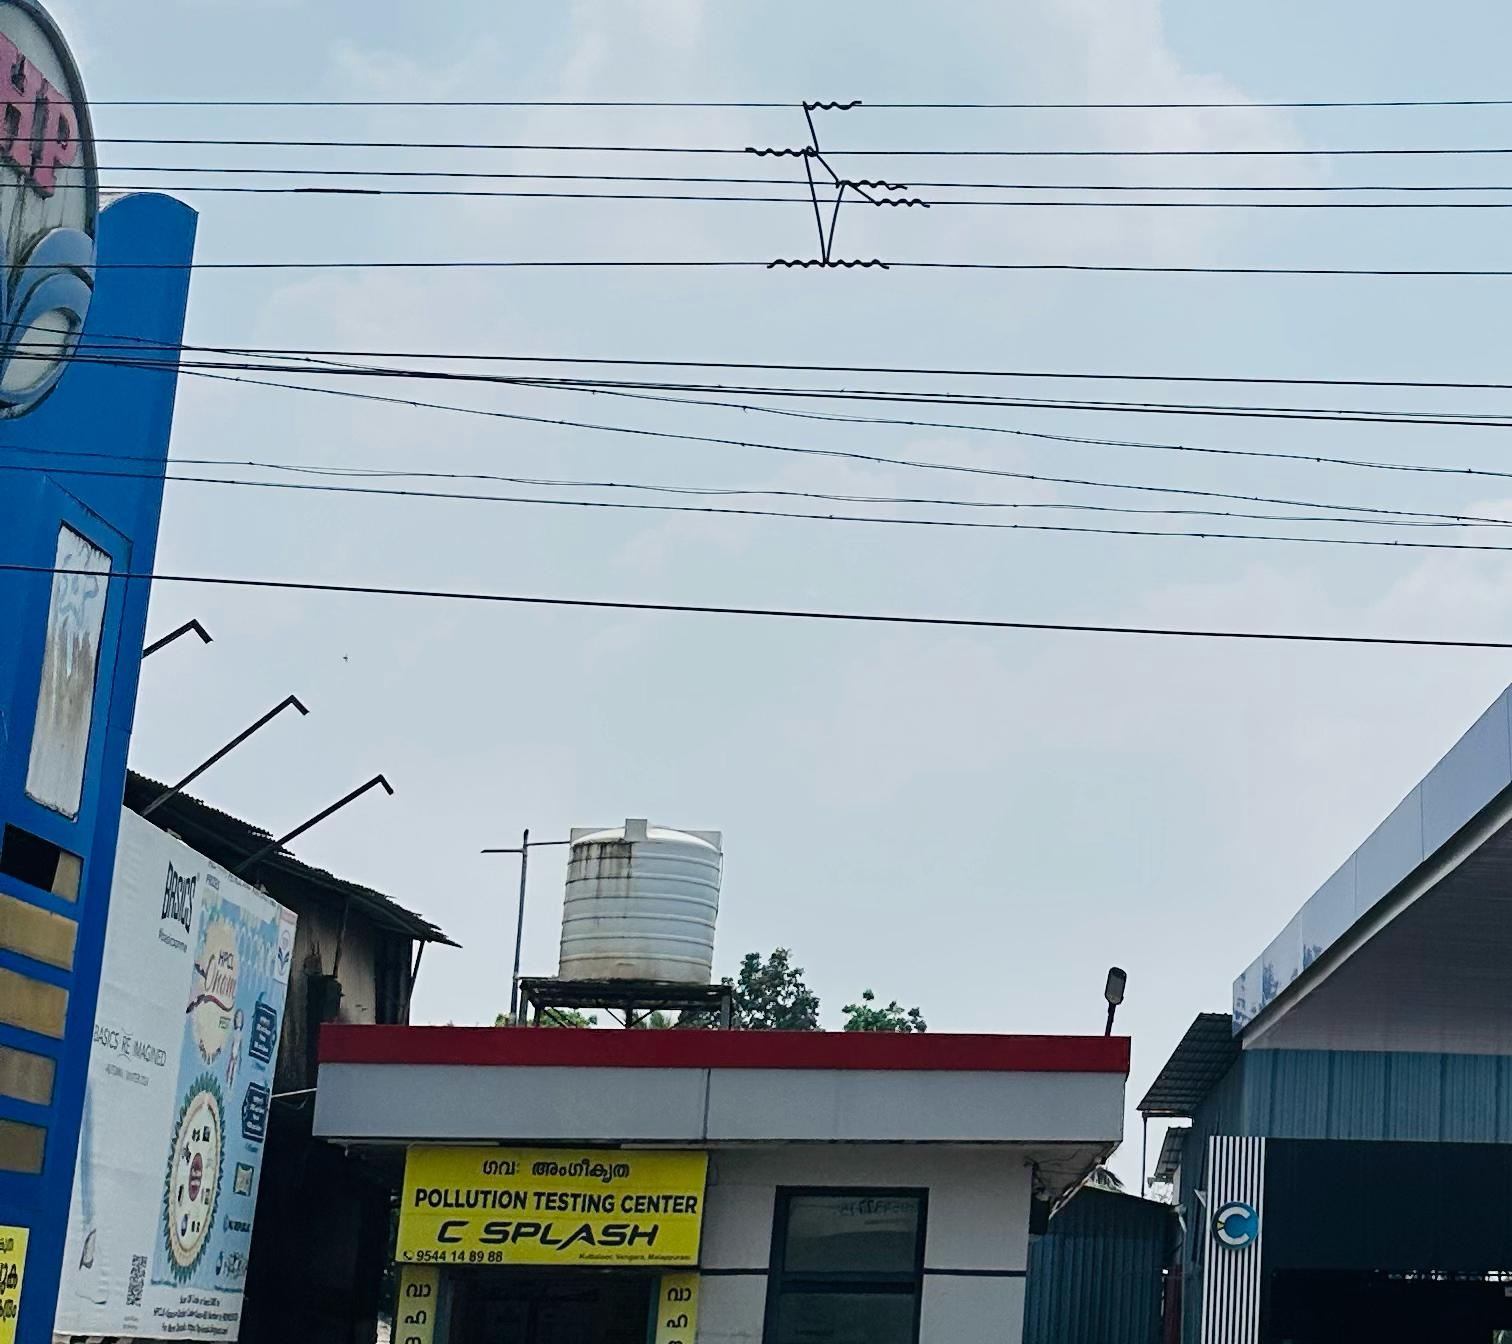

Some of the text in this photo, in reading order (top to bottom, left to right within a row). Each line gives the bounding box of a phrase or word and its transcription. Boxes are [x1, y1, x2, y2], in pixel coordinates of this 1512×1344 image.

[161, 861, 197, 934] BASICS
[415, 1188, 698, 1214] POLLUTION TESTING CENTER
[437, 1220, 659, 1251] C SPLASH
[416, 1250, 503, 1263] 9544 14 89 88
